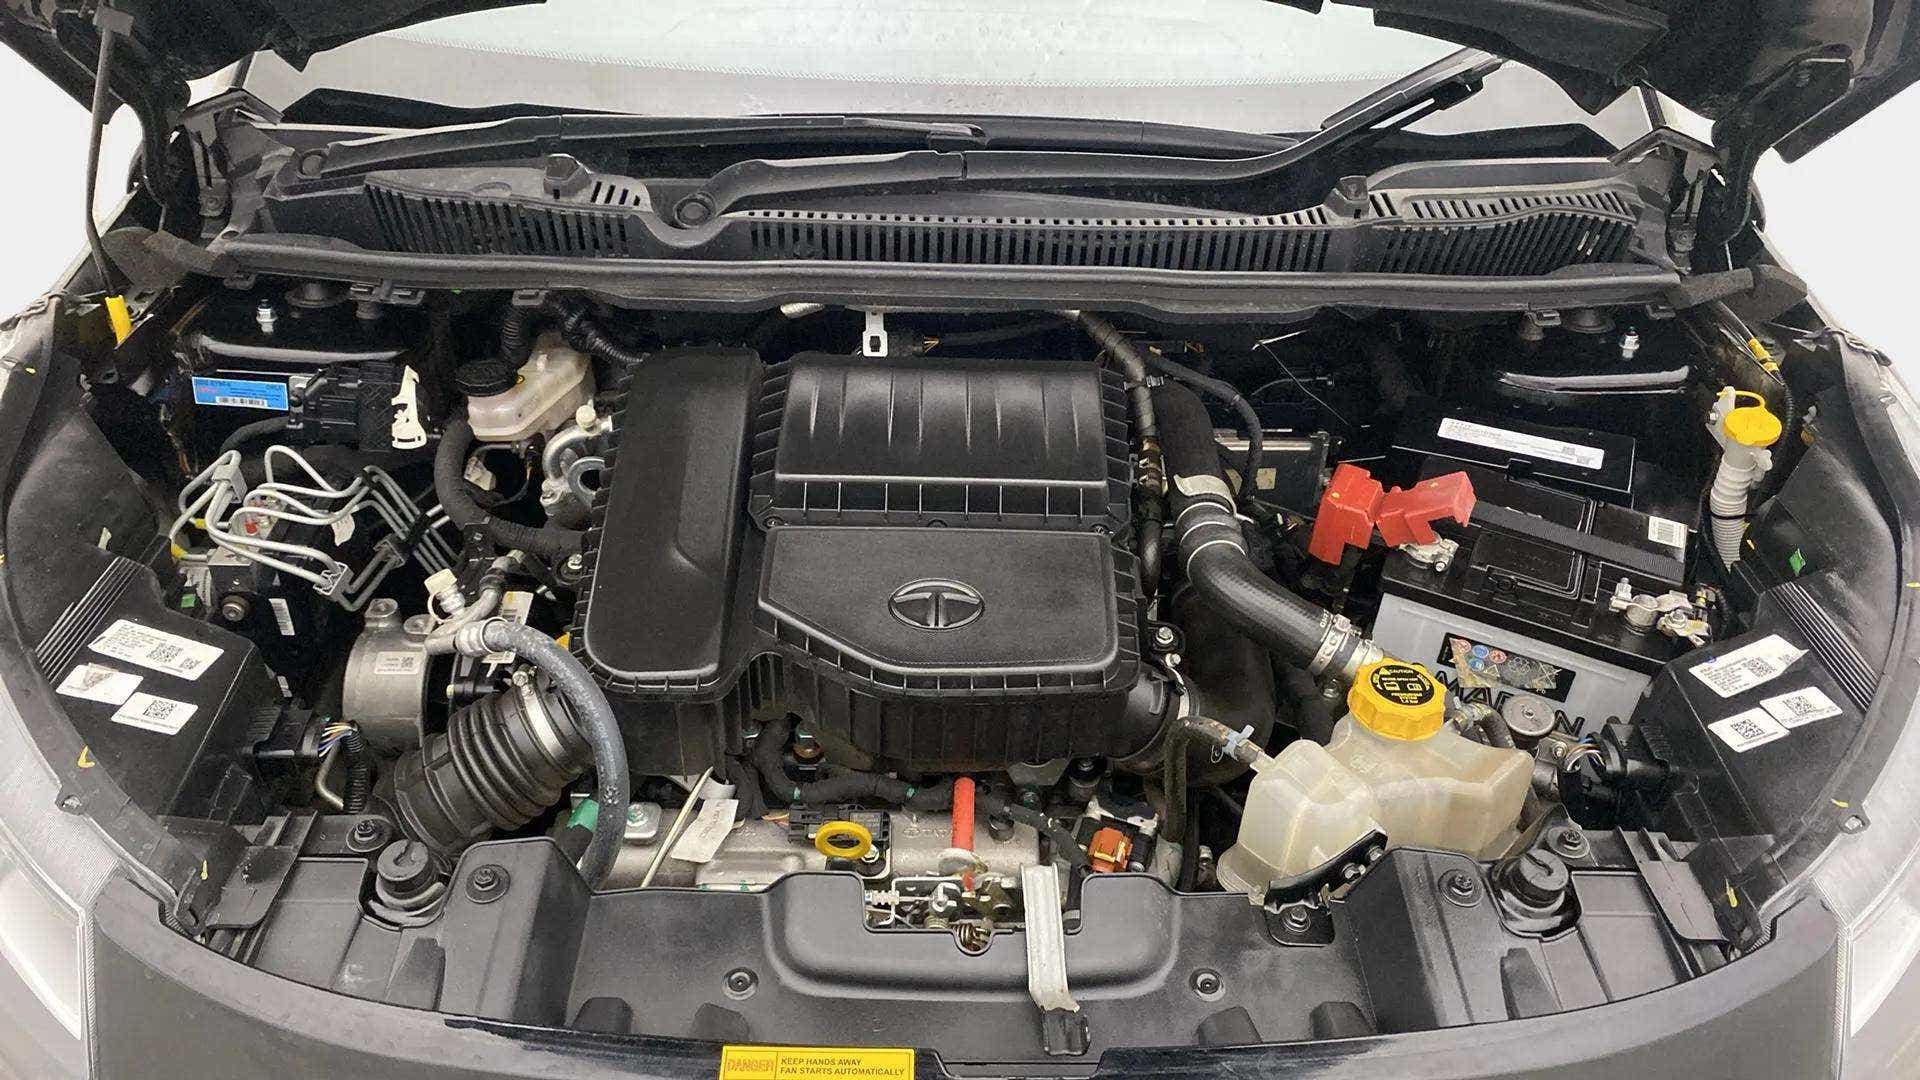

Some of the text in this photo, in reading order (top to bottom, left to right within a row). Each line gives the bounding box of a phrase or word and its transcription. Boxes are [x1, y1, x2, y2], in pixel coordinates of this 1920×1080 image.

[727, 1058, 774, 1072] DANGER
[781, 1057, 804, 1065] KEEP
[806, 1058, 836, 1066] HANDS
[799, 1067, 832, 1075] STARTS
[834, 1067, 905, 1076] AUTOMATICALLY
